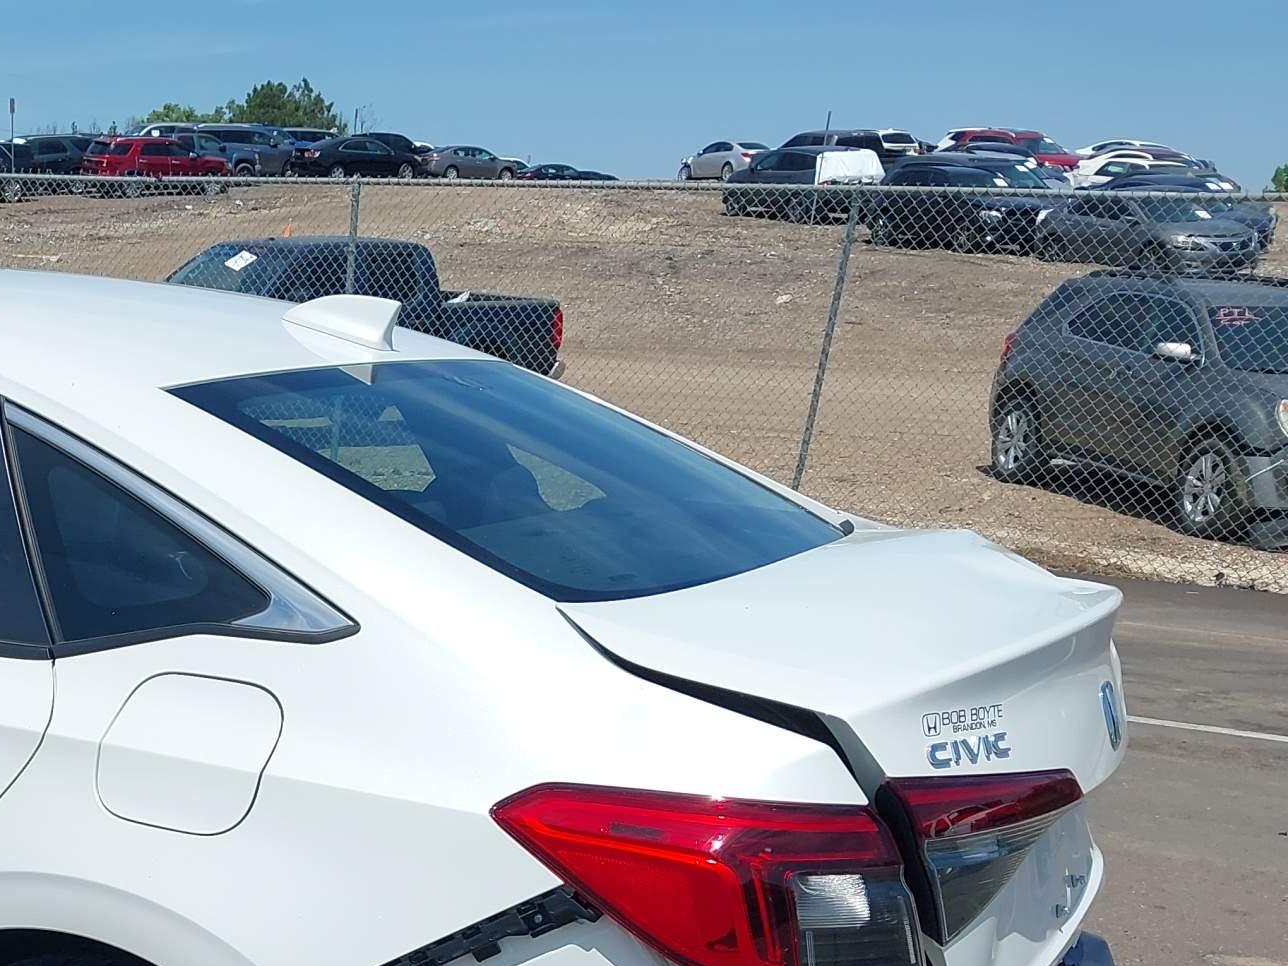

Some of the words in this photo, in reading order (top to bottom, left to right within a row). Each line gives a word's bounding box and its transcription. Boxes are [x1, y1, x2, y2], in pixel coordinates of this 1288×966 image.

[942, 709, 967, 726] BOB
[971, 703, 1003, 722] BOYTE
[927, 731, 1012, 769] CIVIC
